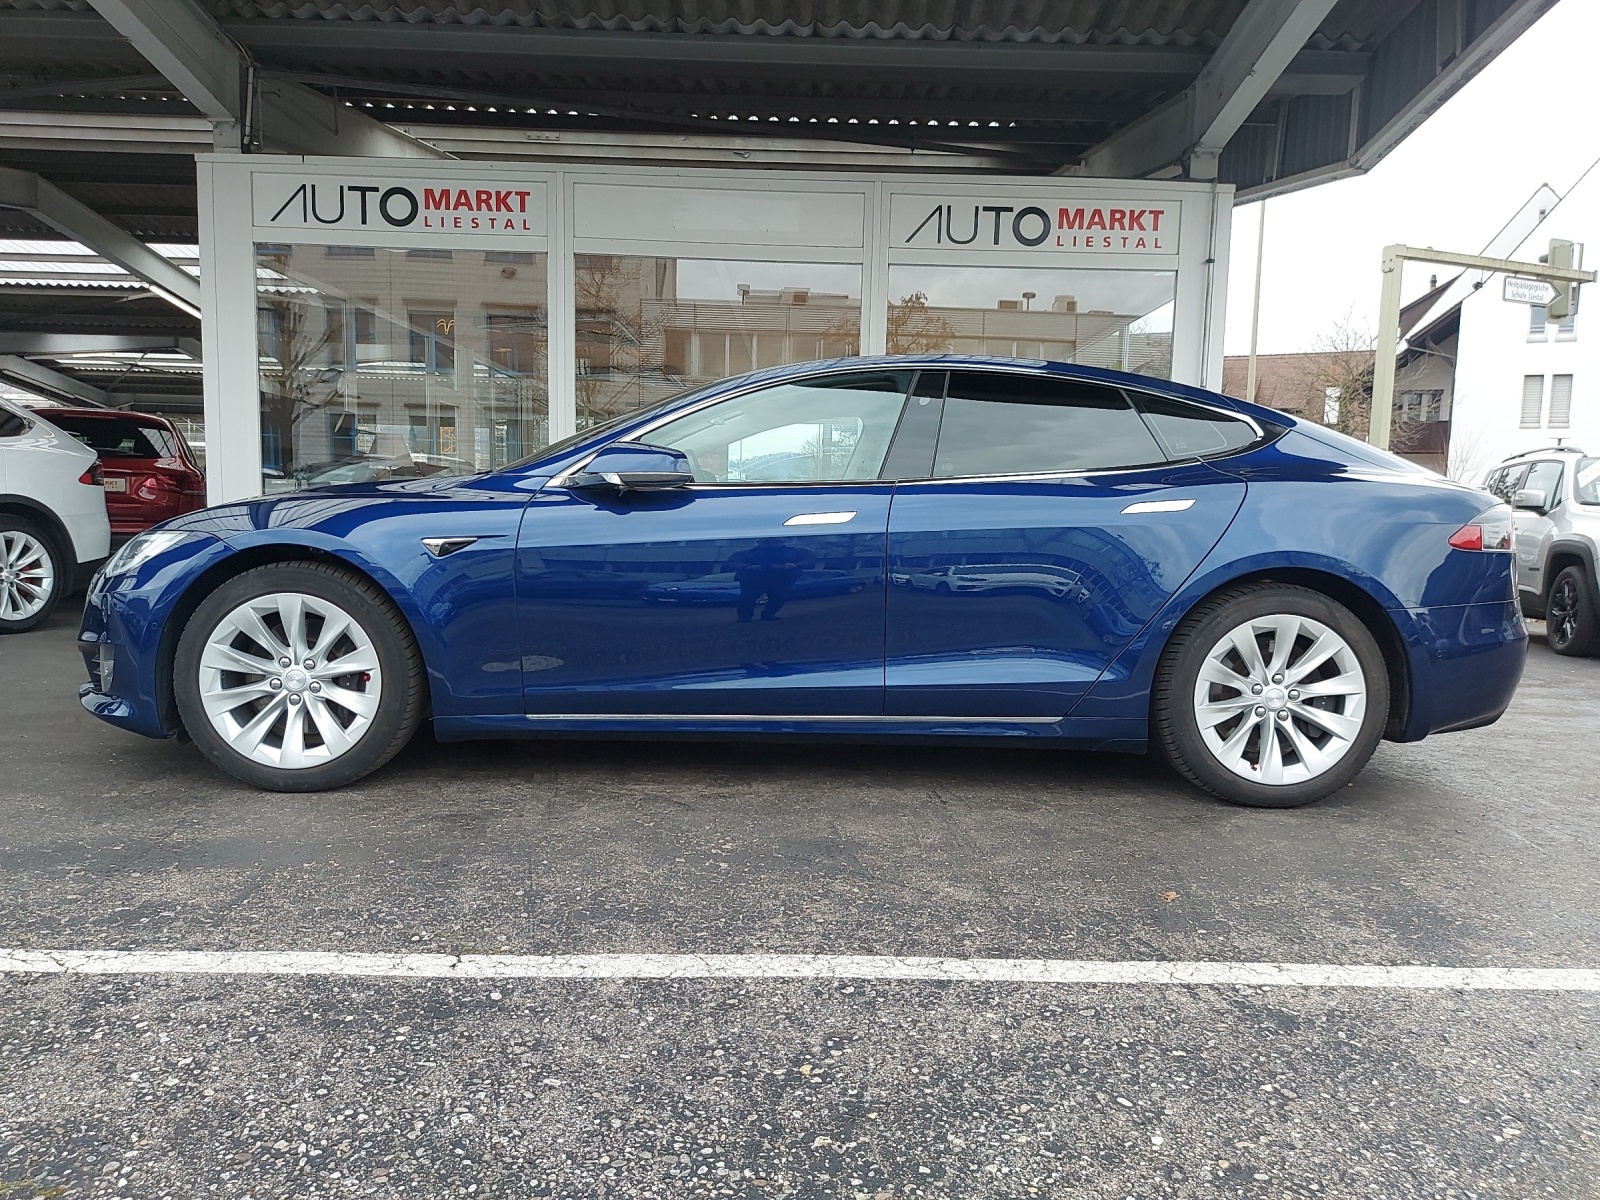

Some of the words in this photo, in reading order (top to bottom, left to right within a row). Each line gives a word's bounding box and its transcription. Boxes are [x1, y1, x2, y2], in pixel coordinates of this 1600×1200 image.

[270, 183, 419, 228] AUTO
[423, 188, 531, 213] MARKT
[423, 216, 531, 231] LIESTAL
[904, 204, 1052, 247] AUTO
[1057, 208, 1165, 231] MARKT
[1056, 235, 1163, 249] LIESTAL
[1508, 280, 1549, 292] Heilpädagogische
[1511, 291, 1527, 299] Schule
[1528, 293, 1544, 301] Liestal
